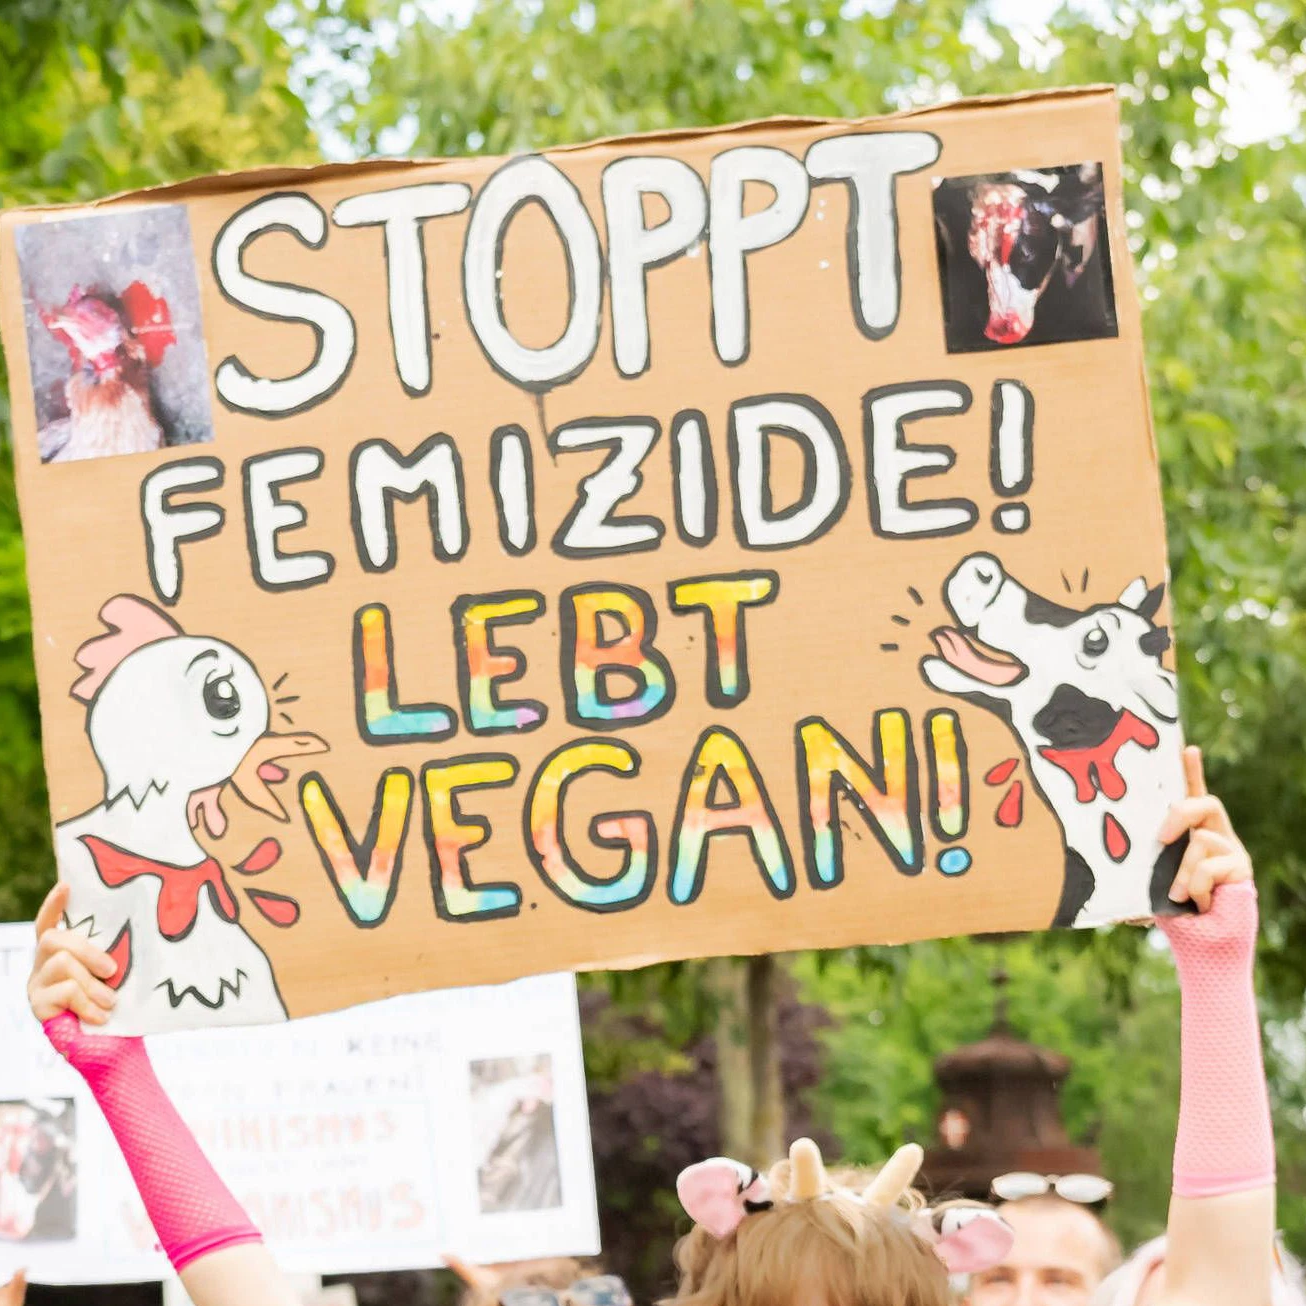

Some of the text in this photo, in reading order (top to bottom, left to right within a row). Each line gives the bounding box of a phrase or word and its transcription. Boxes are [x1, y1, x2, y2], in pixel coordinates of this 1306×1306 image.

[212, 130, 943, 417] STOPPT
[139, 380, 1036, 604] FEMIZIDE!
[353, 570, 781, 746] LEBT
[297, 708, 972, 929] VEGAN!
